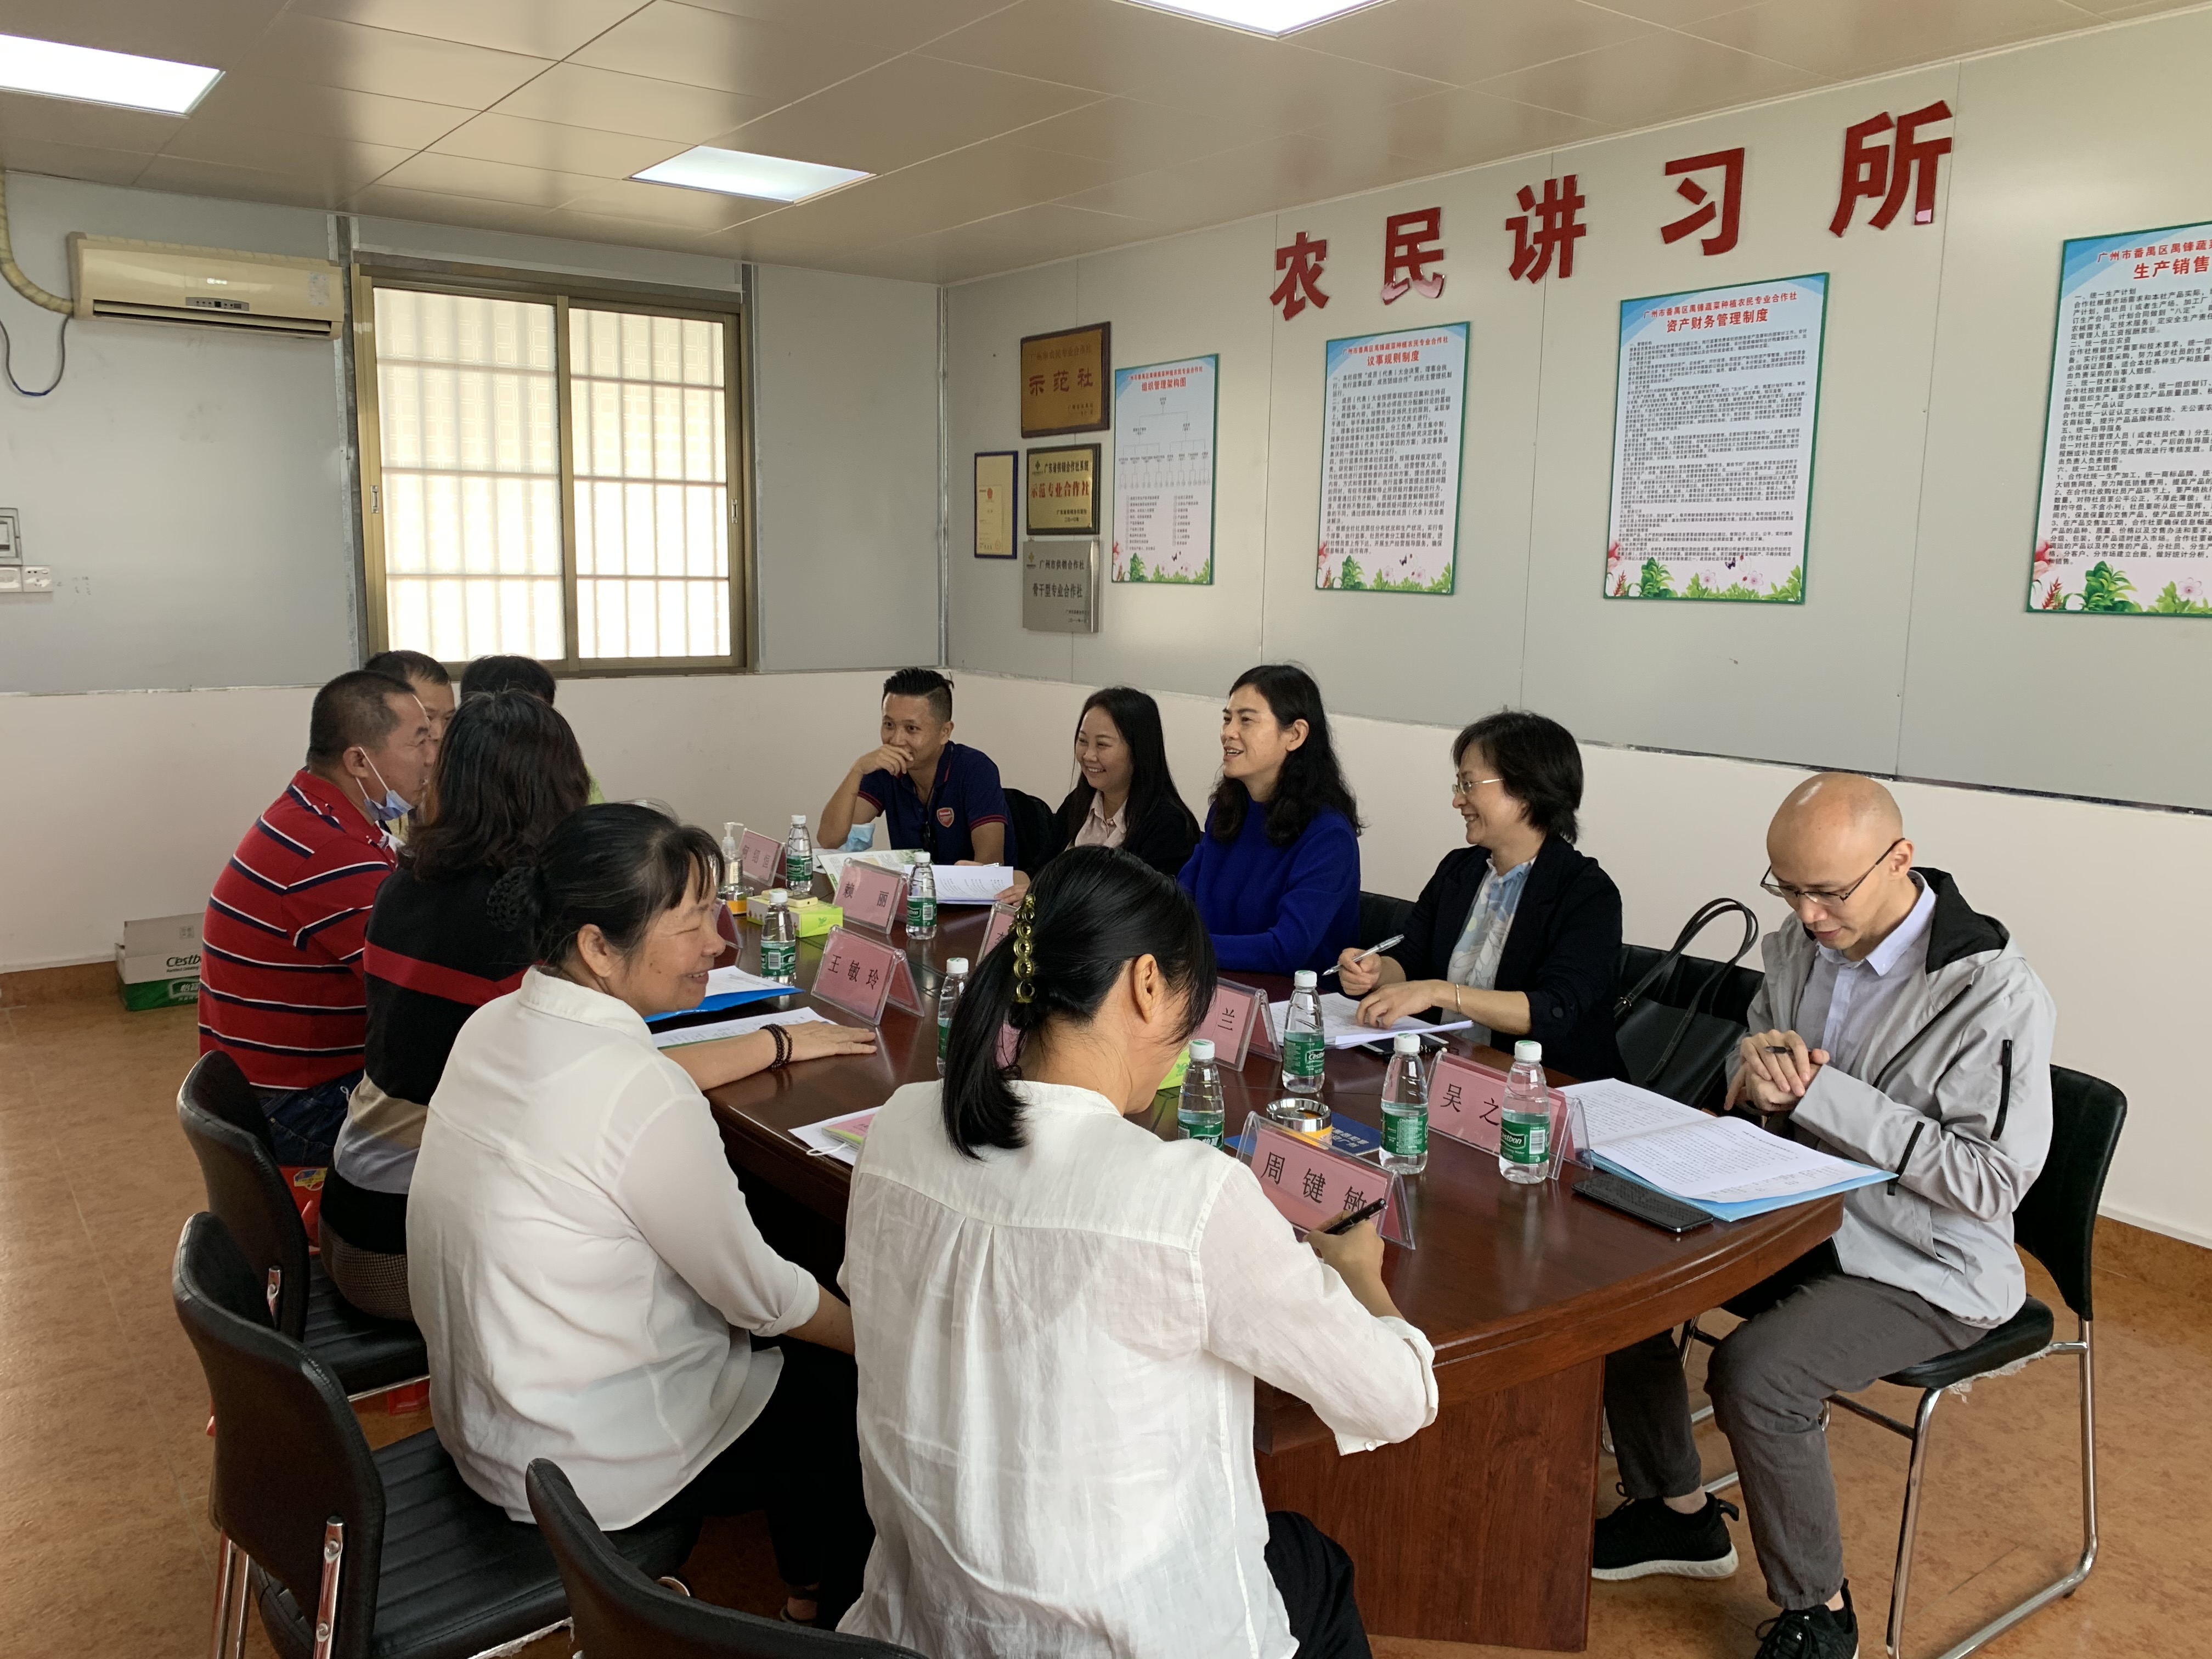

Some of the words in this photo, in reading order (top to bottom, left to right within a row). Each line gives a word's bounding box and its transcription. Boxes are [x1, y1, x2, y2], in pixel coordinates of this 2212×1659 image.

[1269, 100, 1953, 321] 农民讲习所
[2097, 239, 2212, 263] 广州市番禺区禺锋蔬
[2133, 256, 2210, 279] 生产销售
[2074, 288, 2136, 299] 一、统一生产计划
[2074, 289, 2212, 308] 合作社根据市场需求和本社产品实际，
[1643, 291, 1797, 319] 广州市番禺区禺锋蔬菜种植农民专业合作社
[2073, 296, 2212, 317] 产计划，由社员（或者生产场、加工厂
[1666, 307, 1769, 332] 资产财务管理制度
[2070, 326, 2160, 340] 定管理人员工资报酬奖惩。
[2069, 338, 2212, 356] 合作社根据生产需要和技术要求，统一组
[2070, 337, 2131, 348] 二、统一供应农资
[1367, 350, 1420, 366] 议事规则制度
[2069, 346, 2211, 364] 备。实行规模采购，努力减少社员的生产
[2067, 367, 2156, 379] 由负责采购的当事人赔偿。
[1028, 368, 1094, 396] 示范社
[1141, 376, 1187, 392] 组织管理架构图
[2066, 377, 2126, 387] 三、统一技术标准
[2063, 400, 2125, 410] 四、统一产品认证
[2063, 404, 2212, 419] 合作社统一认证认定无公害基地、无公害农
[2062, 415, 2175, 426] 名商标等，提升产品品牌和档次。
[2060, 430, 2212, 442] 合作社实行管理人员（或者社员代表）分生
[2061, 425, 2121, 434] 五、统一指导服务
[2059, 437, 2212, 449] 统一对社员进行产前、产中、产后的指导服
[2058, 457, 2123, 465] 由负责人负责赔偿。
[2057, 470, 2212, 480] 1、合作社统一生产加工，统一商标品牌，统
[1030, 480, 1090, 499] 示范专业合作社
[2053, 503, 2212, 511] 履约守信，不贪小利；社员要听从统一指挥，
[1039, 558, 1085, 571] 广州市供销合作社
[1032, 582, 1083, 599] 骨干型专业合作社
[843, 882, 889, 907] 赖丽
[828, 954, 878, 990] 王敏玲
[1440, 1084, 1500, 1126] 吴之
[1260, 1152, 1367, 1212] 周键敏
